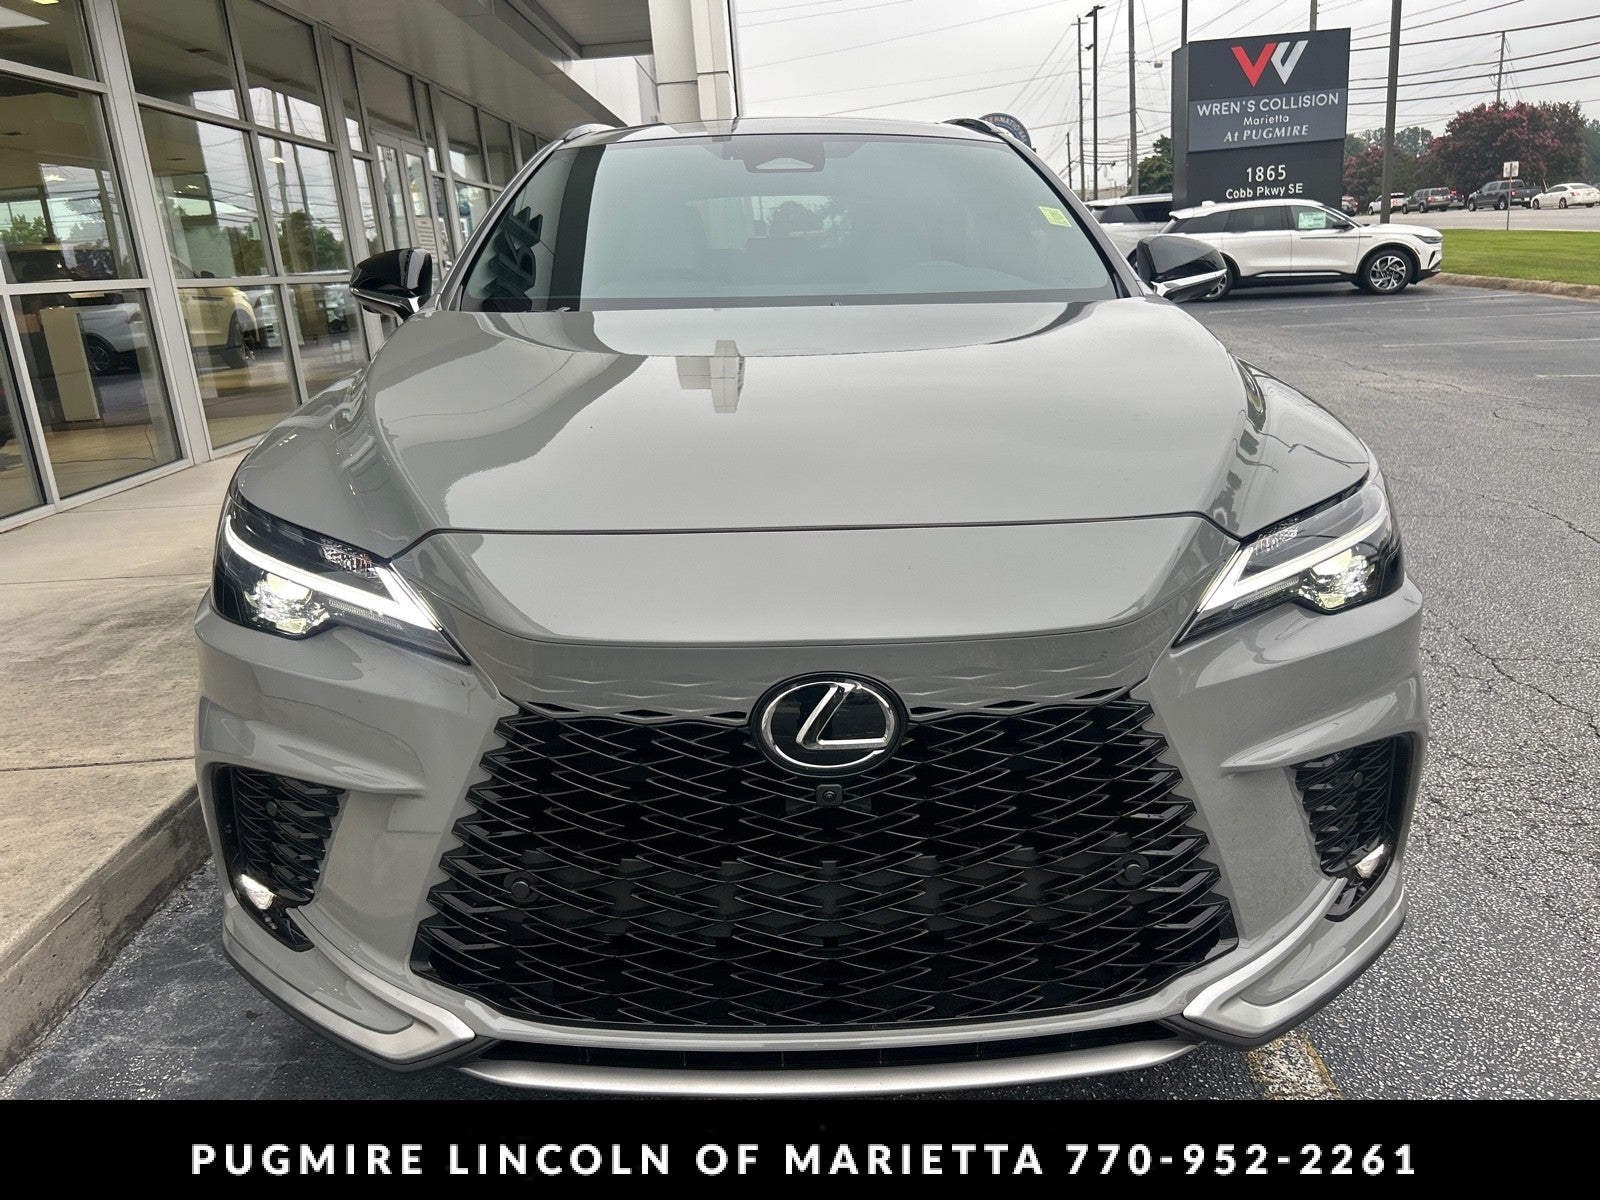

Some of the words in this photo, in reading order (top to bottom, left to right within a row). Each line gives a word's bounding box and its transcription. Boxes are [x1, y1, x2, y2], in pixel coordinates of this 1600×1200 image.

[1197, 99, 1256, 117] WREN'S
[1259, 92, 1339, 112] COLLISION
[1243, 114, 1289, 126] Marietta
[1223, 130, 1239, 143] At
[1242, 124, 1309, 141] PUGMIRE
[1246, 164, 1287, 183] 1865
[1225, 187, 1253, 200] Cobb
[1256, 184, 1286, 197] Pkwy
[1288, 183, 1304, 194] SE
